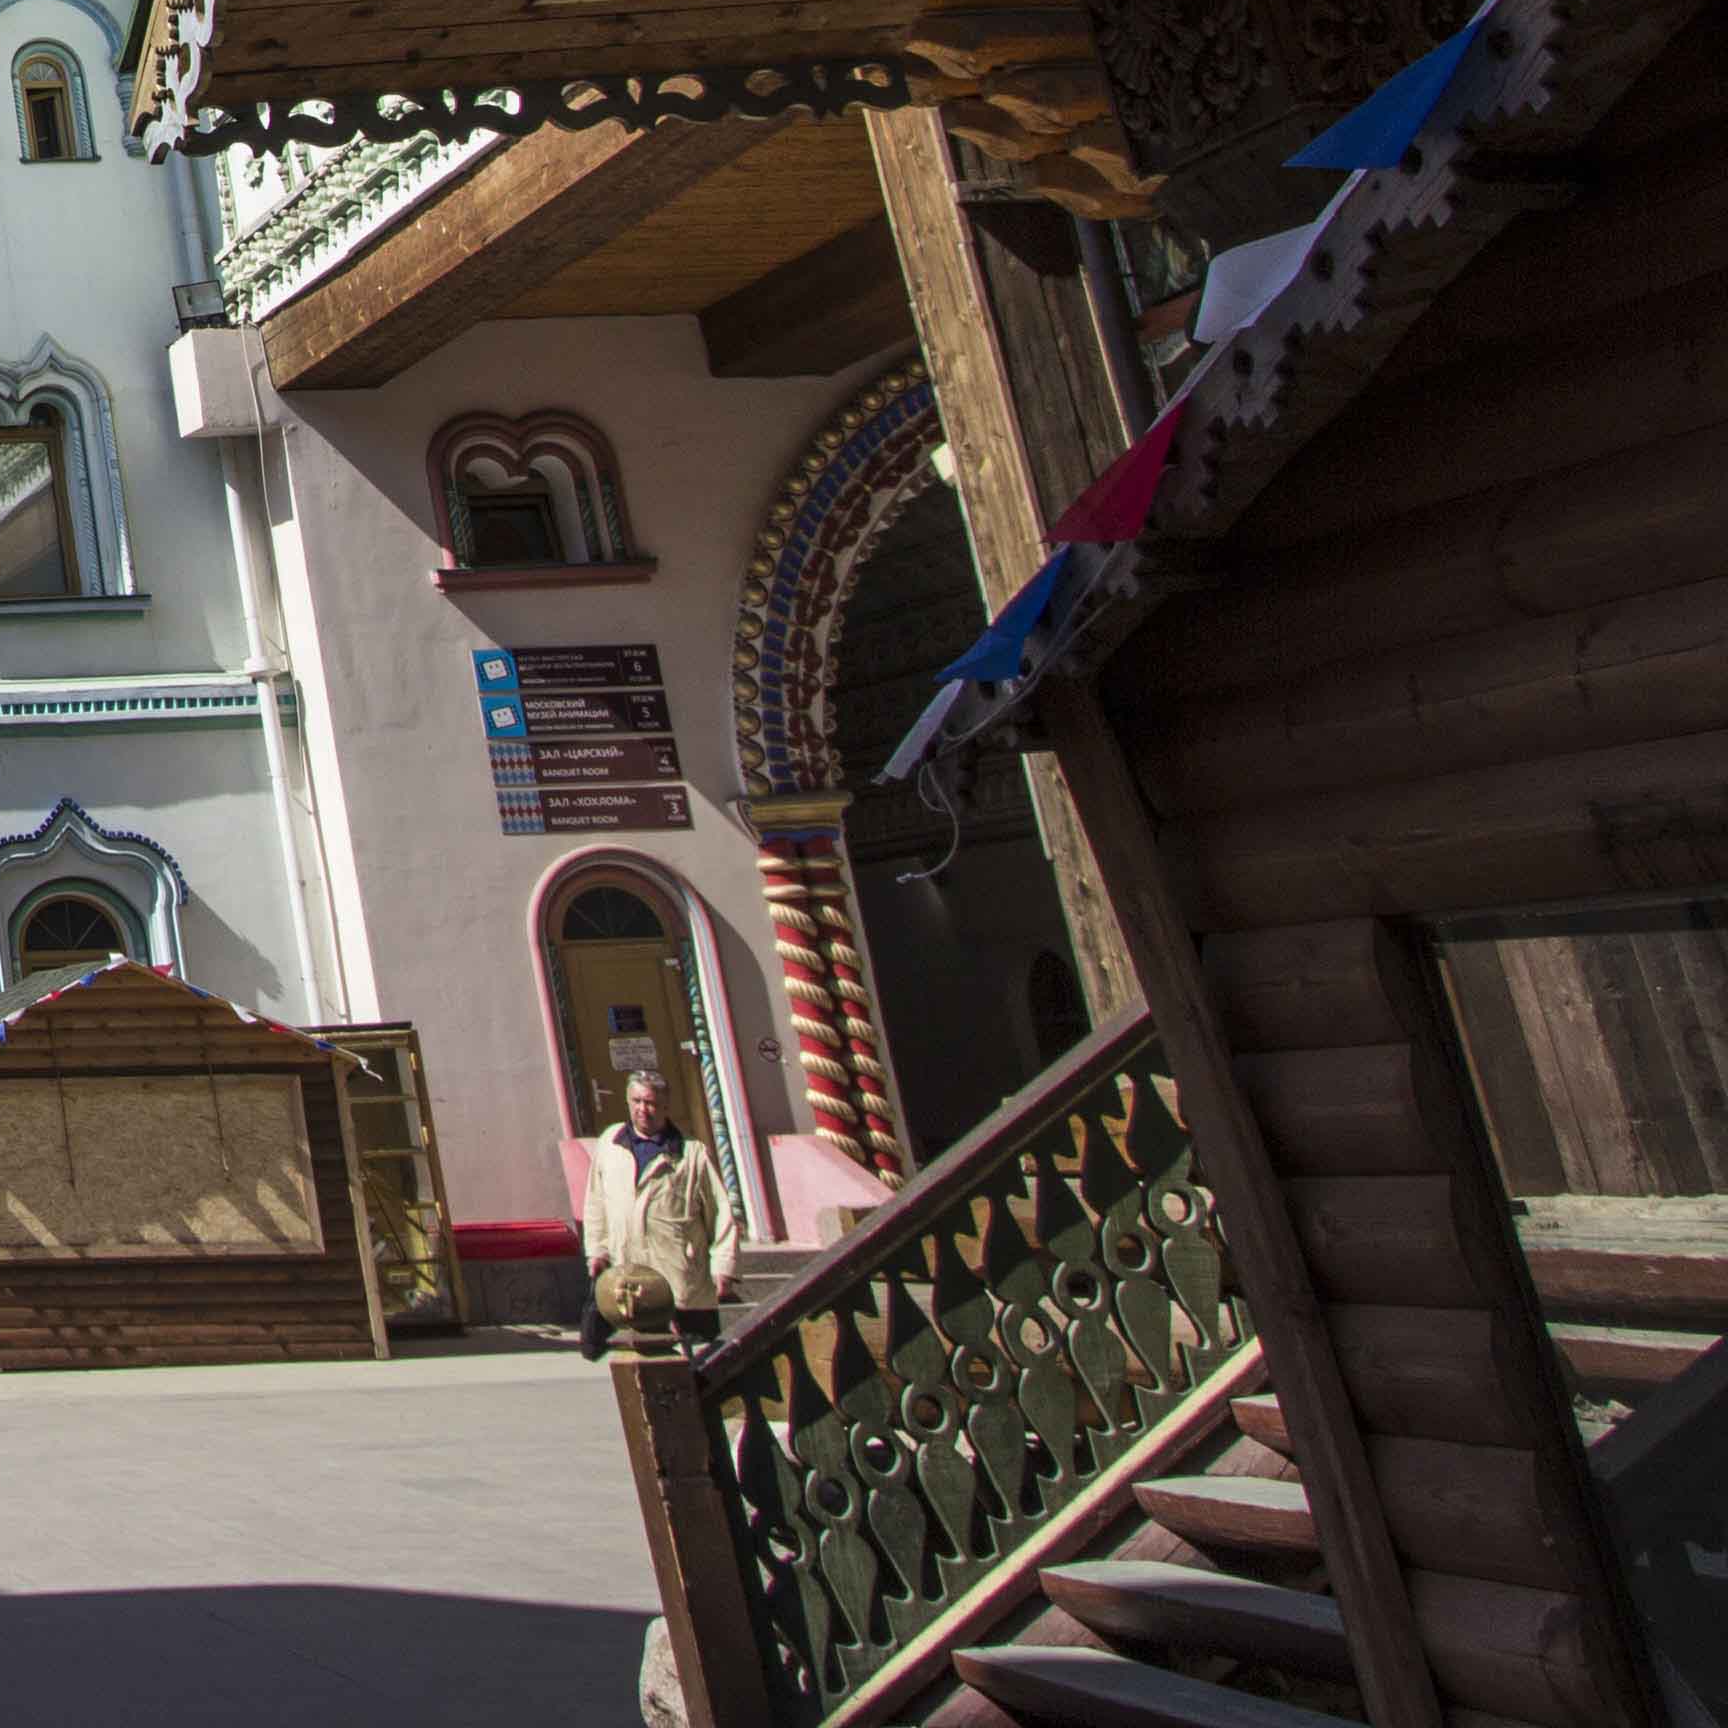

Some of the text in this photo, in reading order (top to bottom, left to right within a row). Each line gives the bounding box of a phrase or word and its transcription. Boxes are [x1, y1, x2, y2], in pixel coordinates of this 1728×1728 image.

[633, 661, 642, 672] 6
[524, 698, 585, 710] МОСКОВСКИЙ
[641, 706, 650, 718] 5
[539, 749, 560, 759] ЗАЛ
[659, 754, 669, 766] 4
[542, 766, 610, 777] BANQUET ROOM
[547, 797, 569, 808] ЗАЛ
[670, 802, 679, 814] 3
[551, 815, 619, 825] BANQUET ROOM
